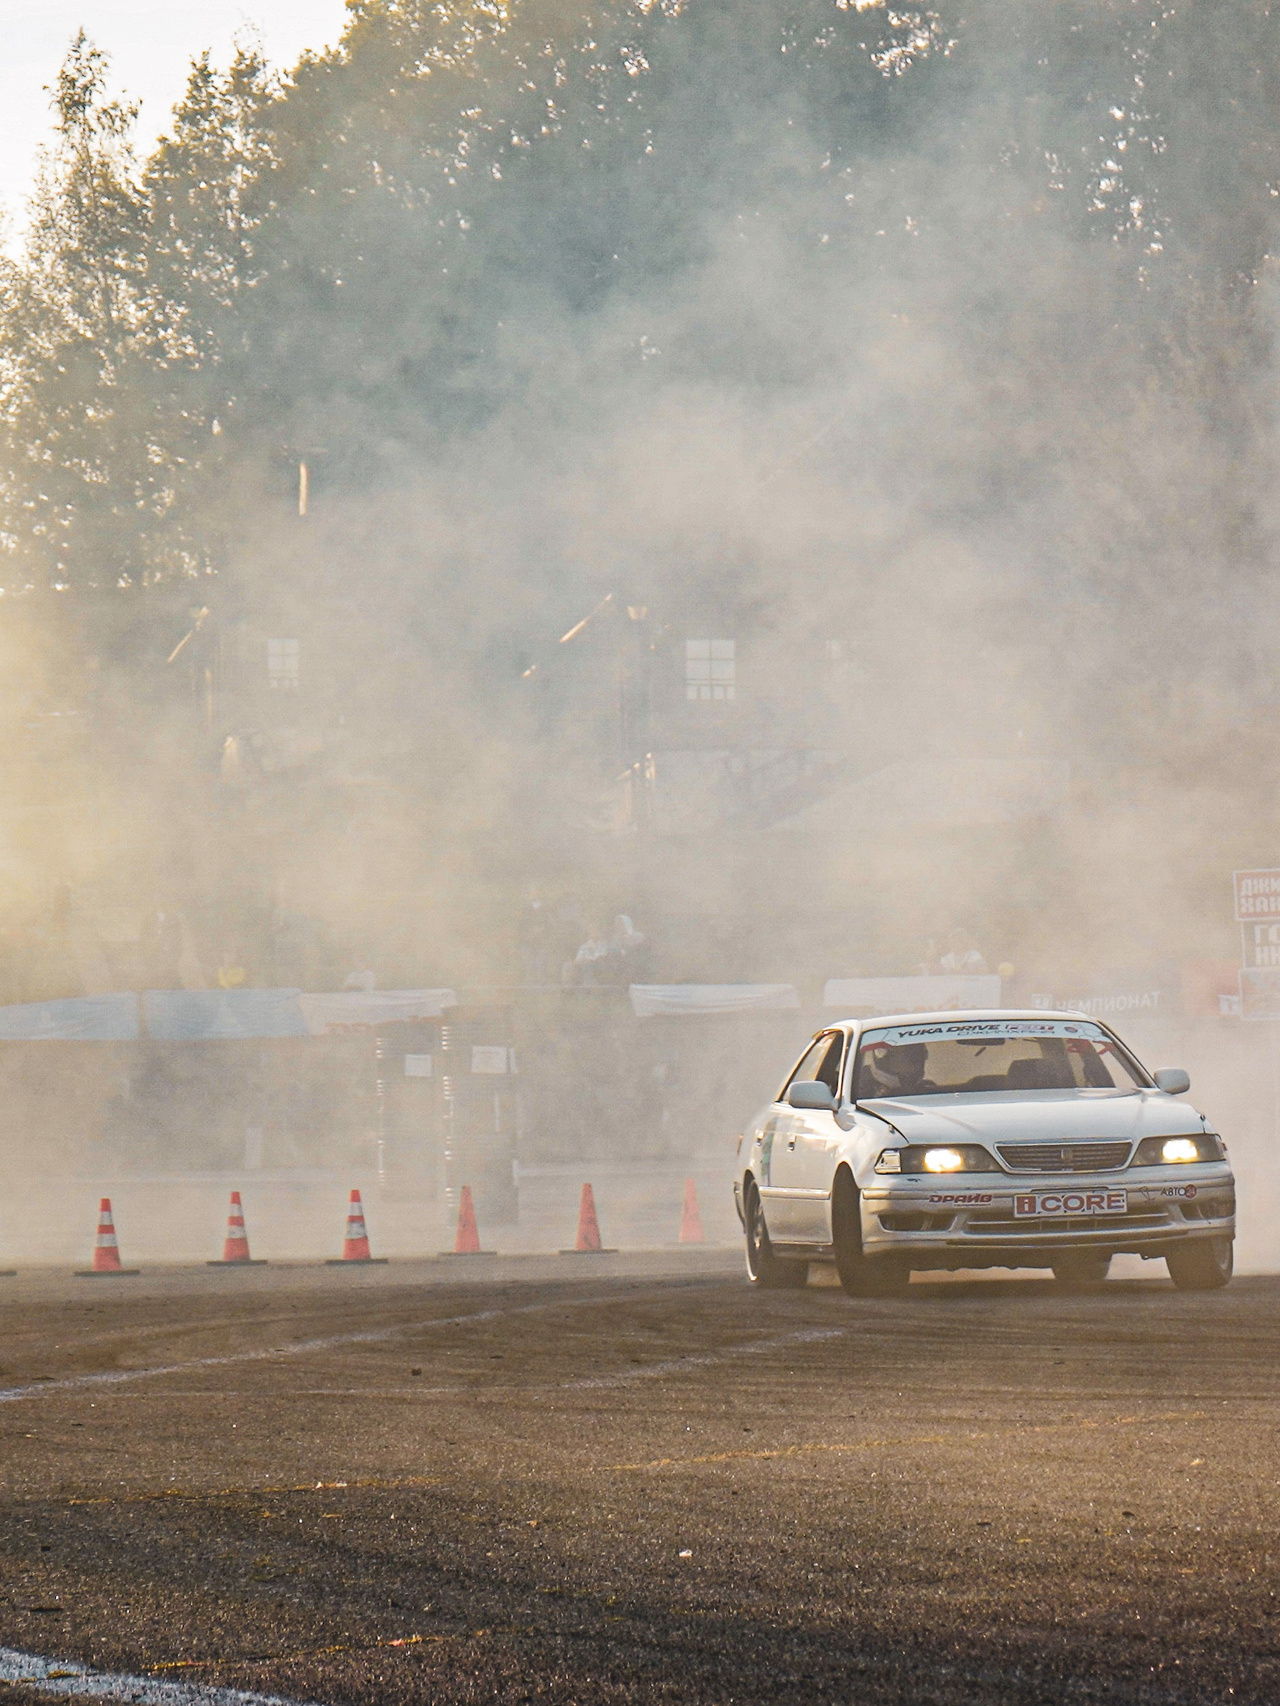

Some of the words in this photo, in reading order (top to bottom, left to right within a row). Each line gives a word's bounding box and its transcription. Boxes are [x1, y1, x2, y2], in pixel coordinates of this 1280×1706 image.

[898, 1027, 943, 1038] YUKA
[946, 1023, 1000, 1034] DRIVE
[928, 1194, 993, 1204] ДРАЙВ
